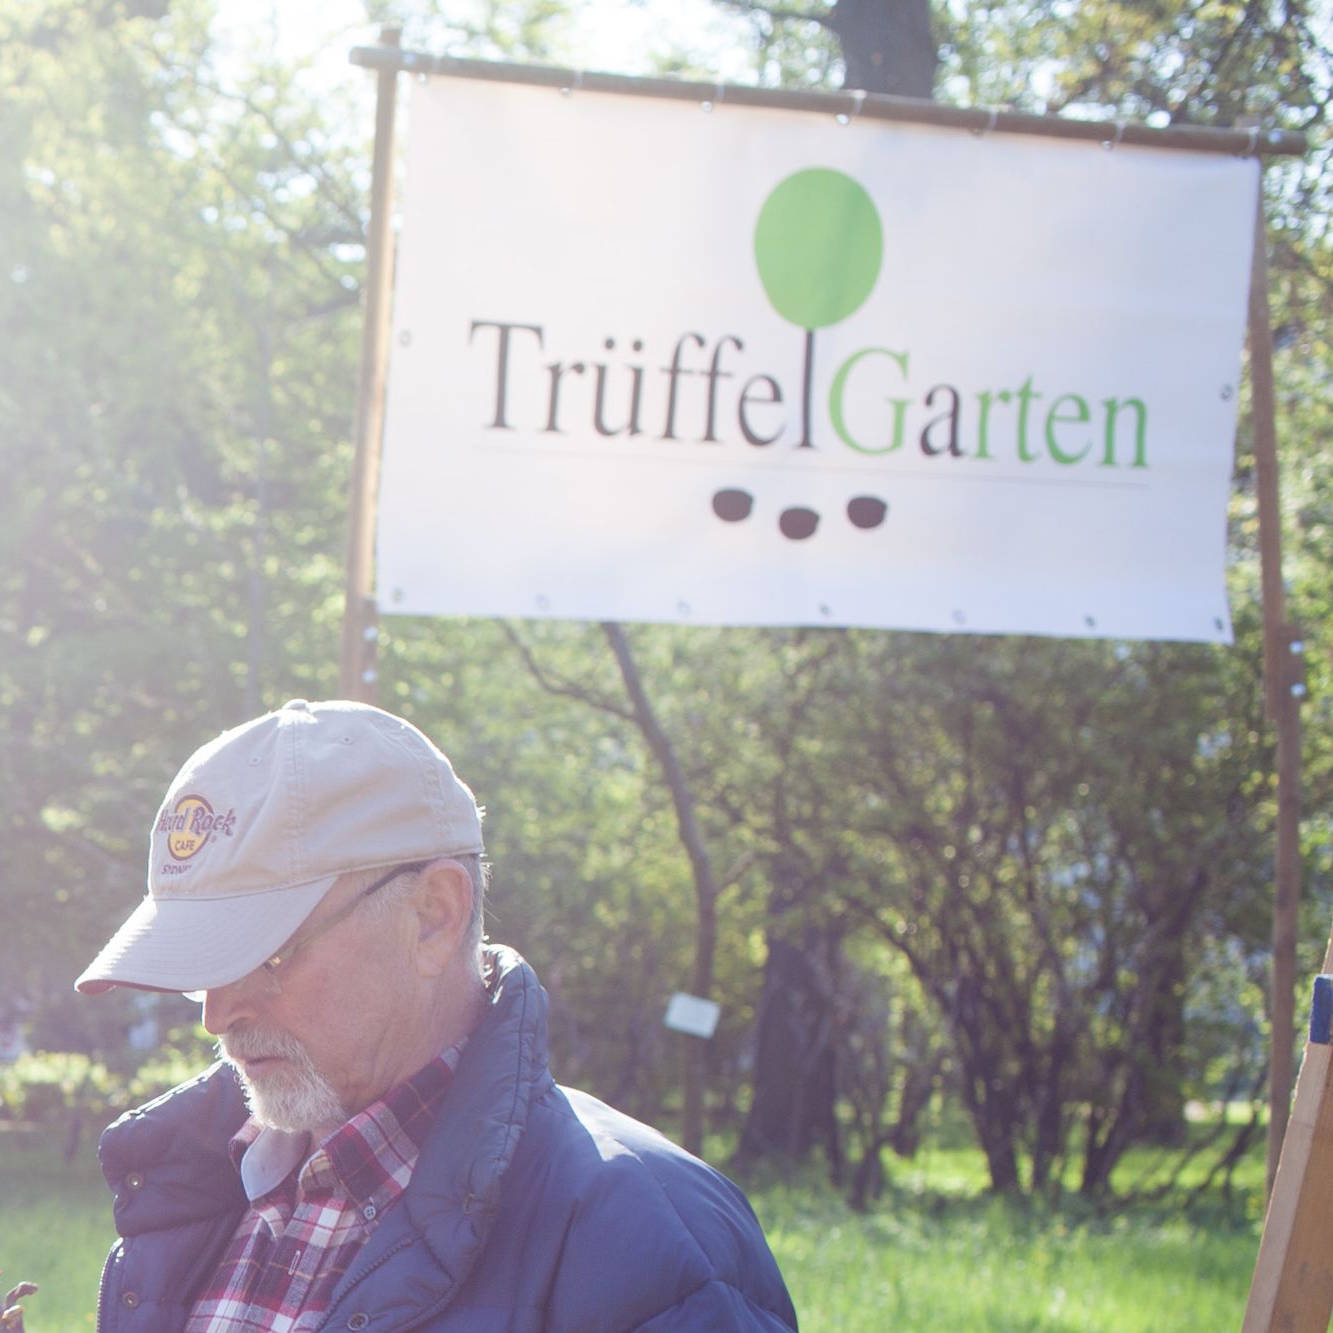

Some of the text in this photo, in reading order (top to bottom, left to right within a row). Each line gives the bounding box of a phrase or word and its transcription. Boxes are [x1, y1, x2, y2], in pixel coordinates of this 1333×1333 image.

[469, 320, 1150, 470] TrüffelGarten
[156, 805, 237, 837] Hard Rock
[174, 839, 196, 852] CAFE
